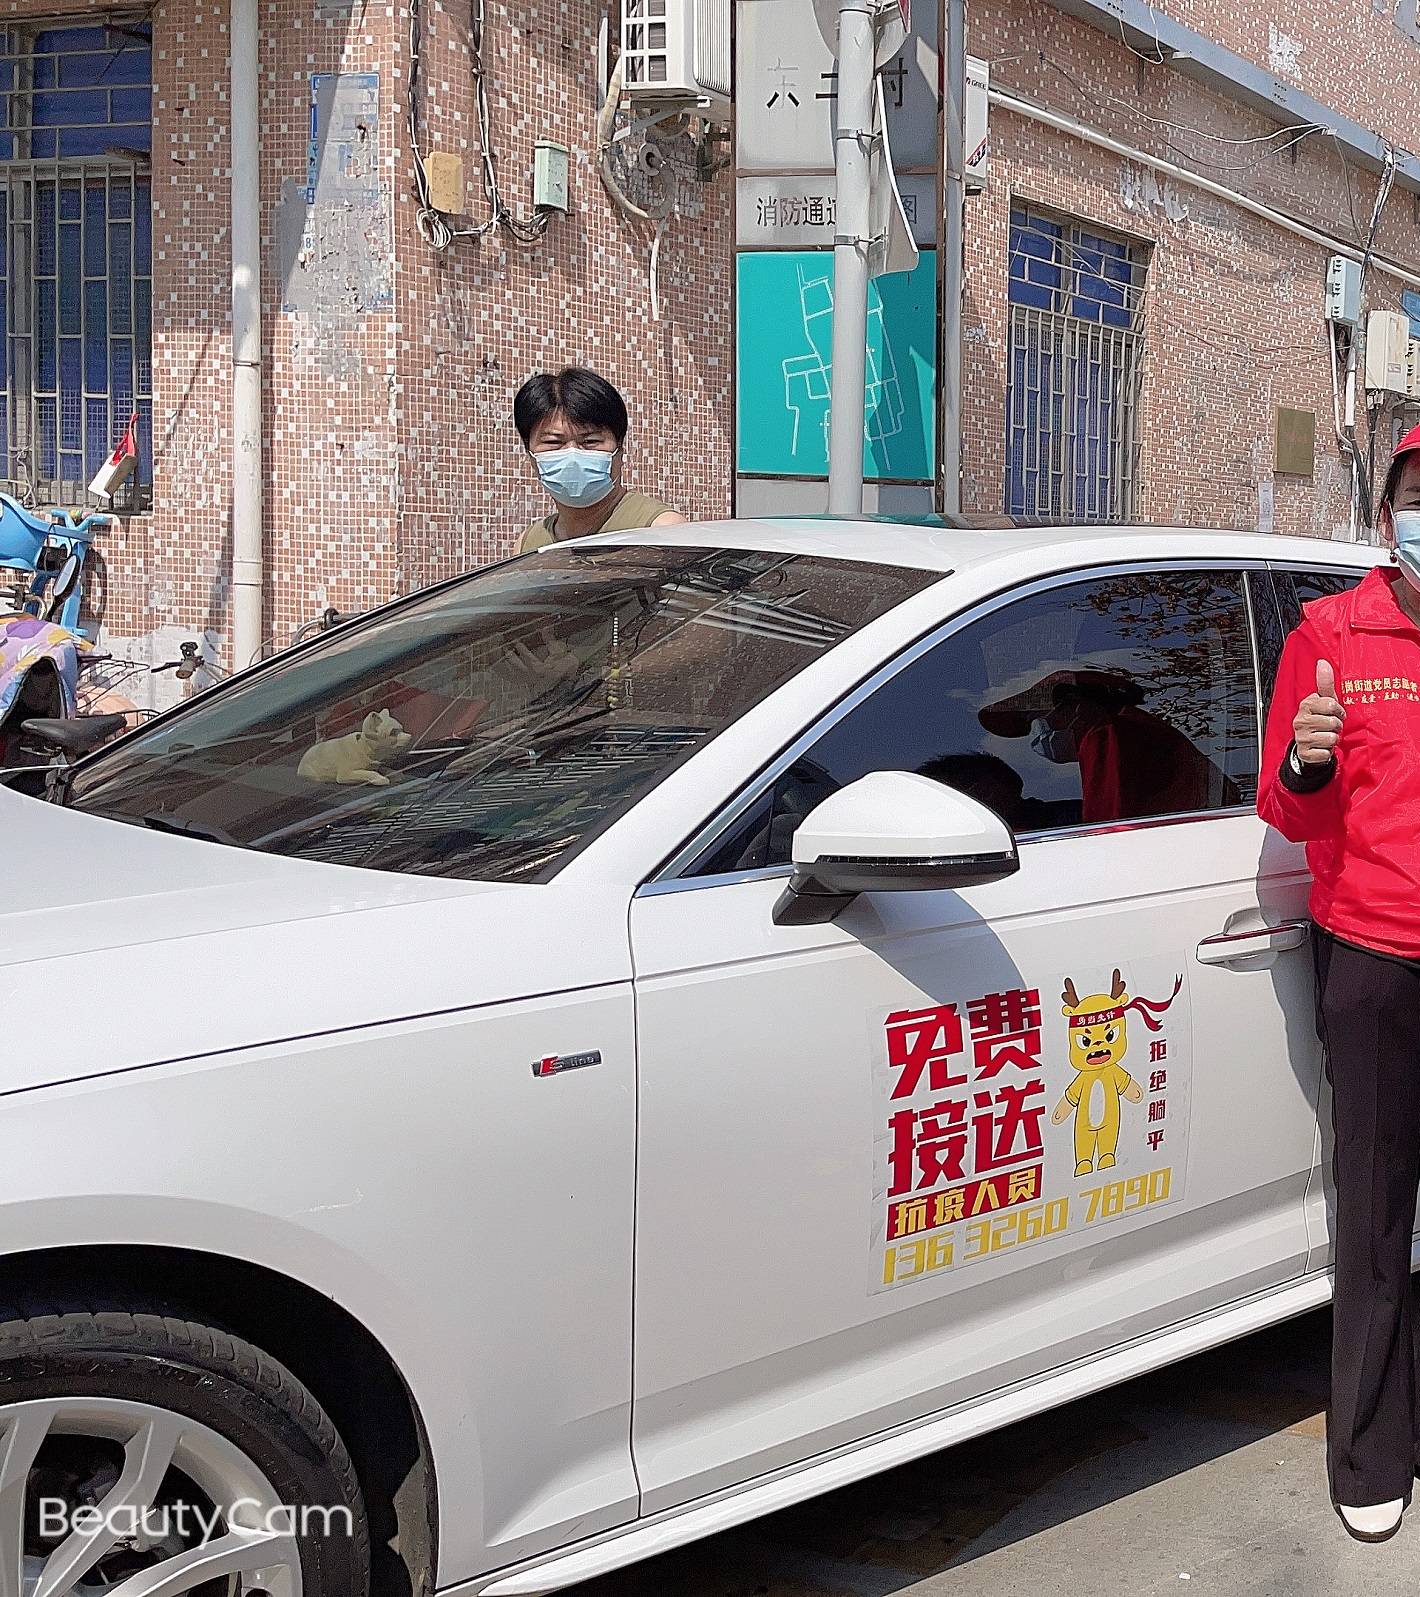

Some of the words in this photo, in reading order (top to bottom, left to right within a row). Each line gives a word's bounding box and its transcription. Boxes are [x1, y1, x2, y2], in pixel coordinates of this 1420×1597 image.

[884, 988, 1041, 1100] 免费
[1147, 1039, 1167, 1151] 拒绝躺平
[887, 1079, 1045, 1198] 接送
[883, 1230, 953, 1284] 136
[963, 1196, 1070, 1261] 3260
[1079, 1167, 1171, 1223] 7890
[894, 1167, 1039, 1237] 抗疫人员
